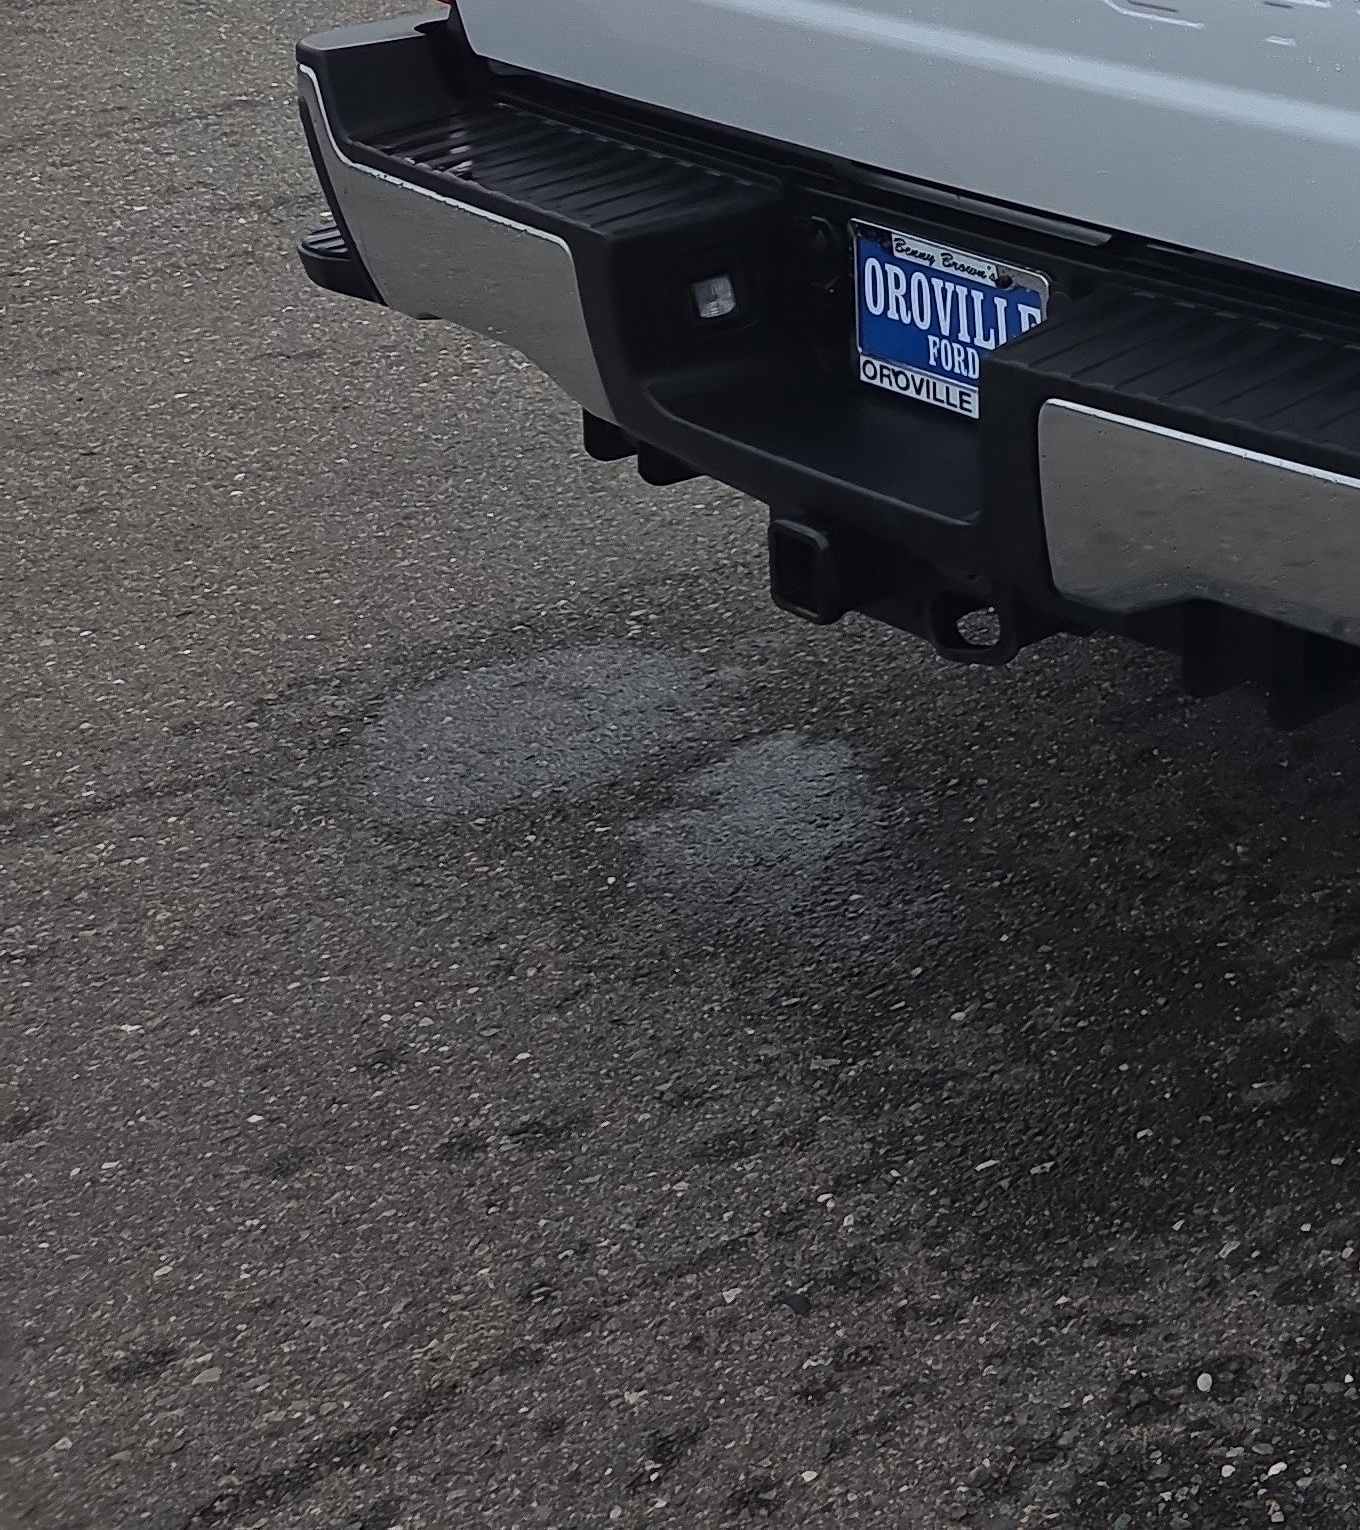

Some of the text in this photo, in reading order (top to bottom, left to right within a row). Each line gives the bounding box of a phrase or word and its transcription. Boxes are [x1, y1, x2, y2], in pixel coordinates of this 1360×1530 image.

[893, 237, 997, 281] Benny Brown's
[927, 334, 980, 380] FORD
[861, 359, 973, 414] OROVILLE
